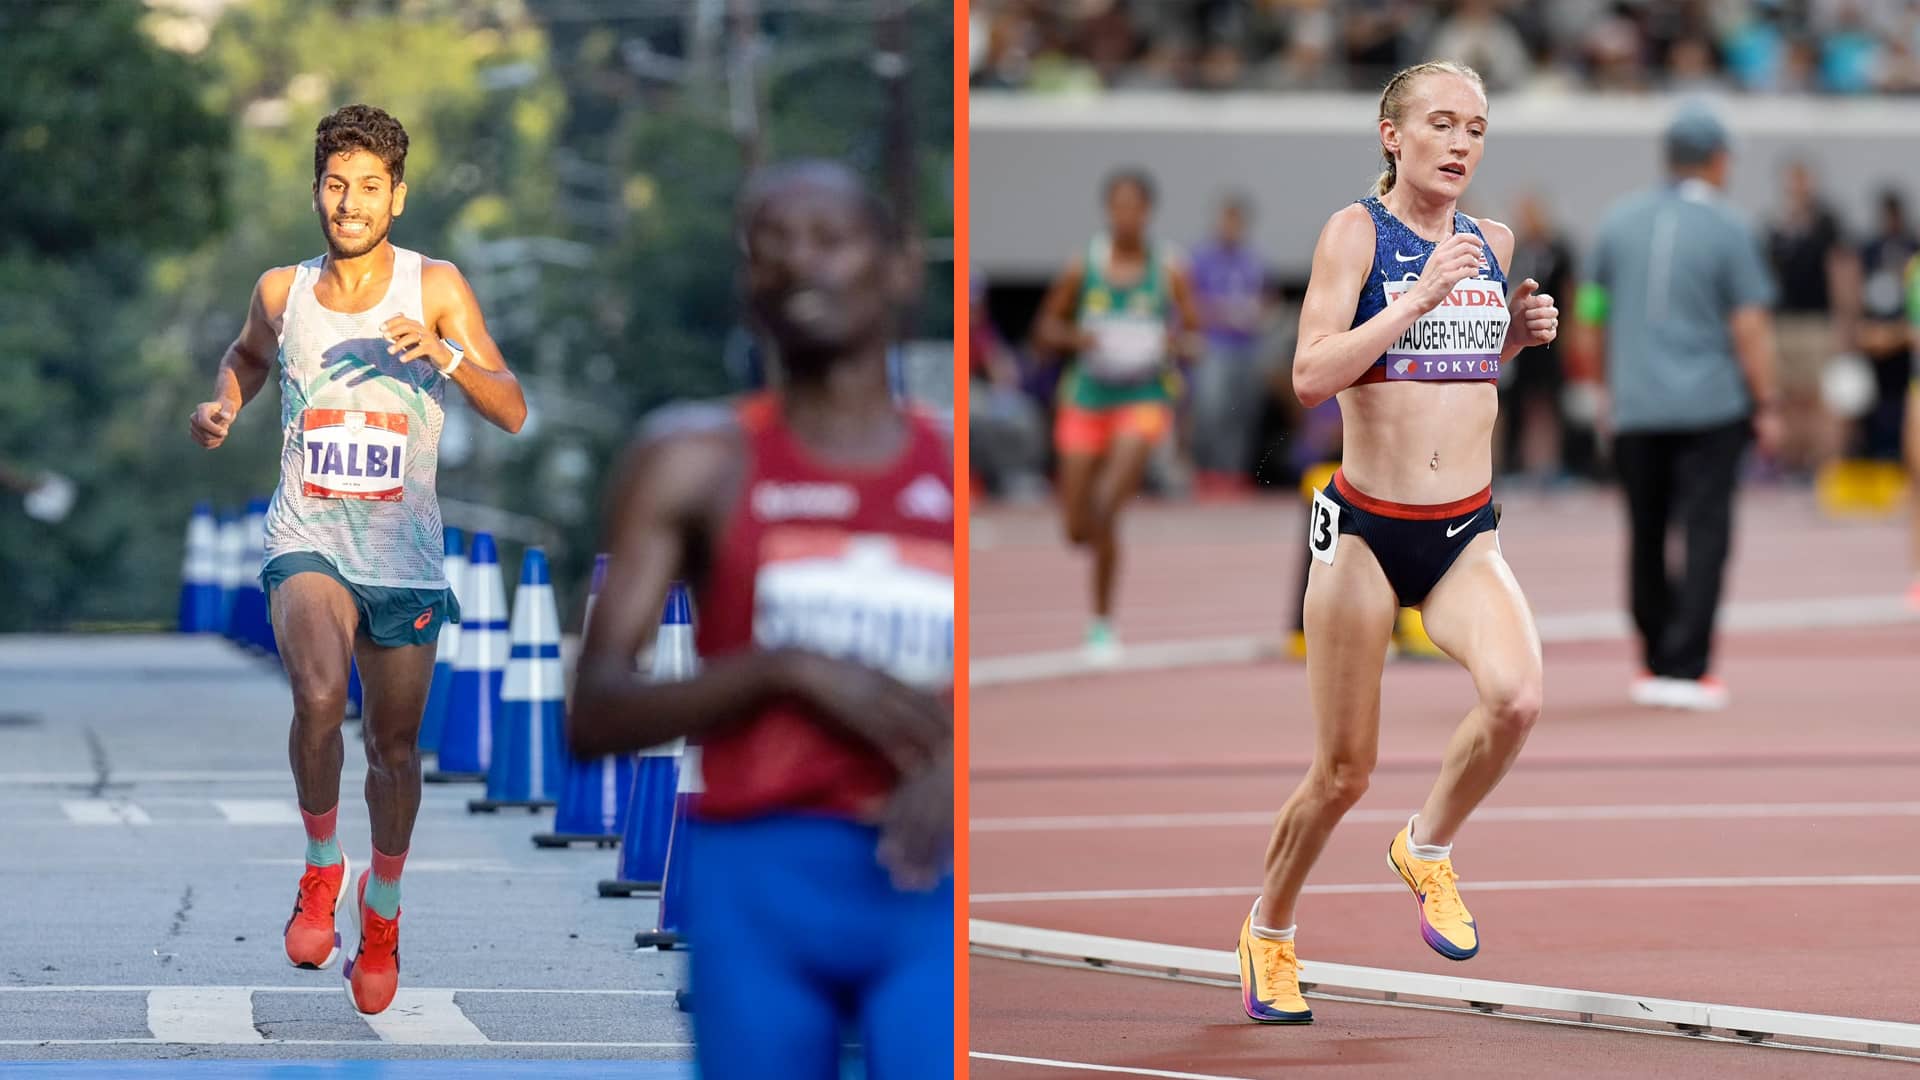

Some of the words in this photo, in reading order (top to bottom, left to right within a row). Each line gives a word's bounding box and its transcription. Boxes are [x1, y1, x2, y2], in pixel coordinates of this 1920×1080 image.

[1388, 289, 1504, 308] NDA
[1392, 320, 1507, 350] AUGER-THACKERY
[307, 441, 401, 479] TALBI
[1312, 500, 1332, 551] 13
